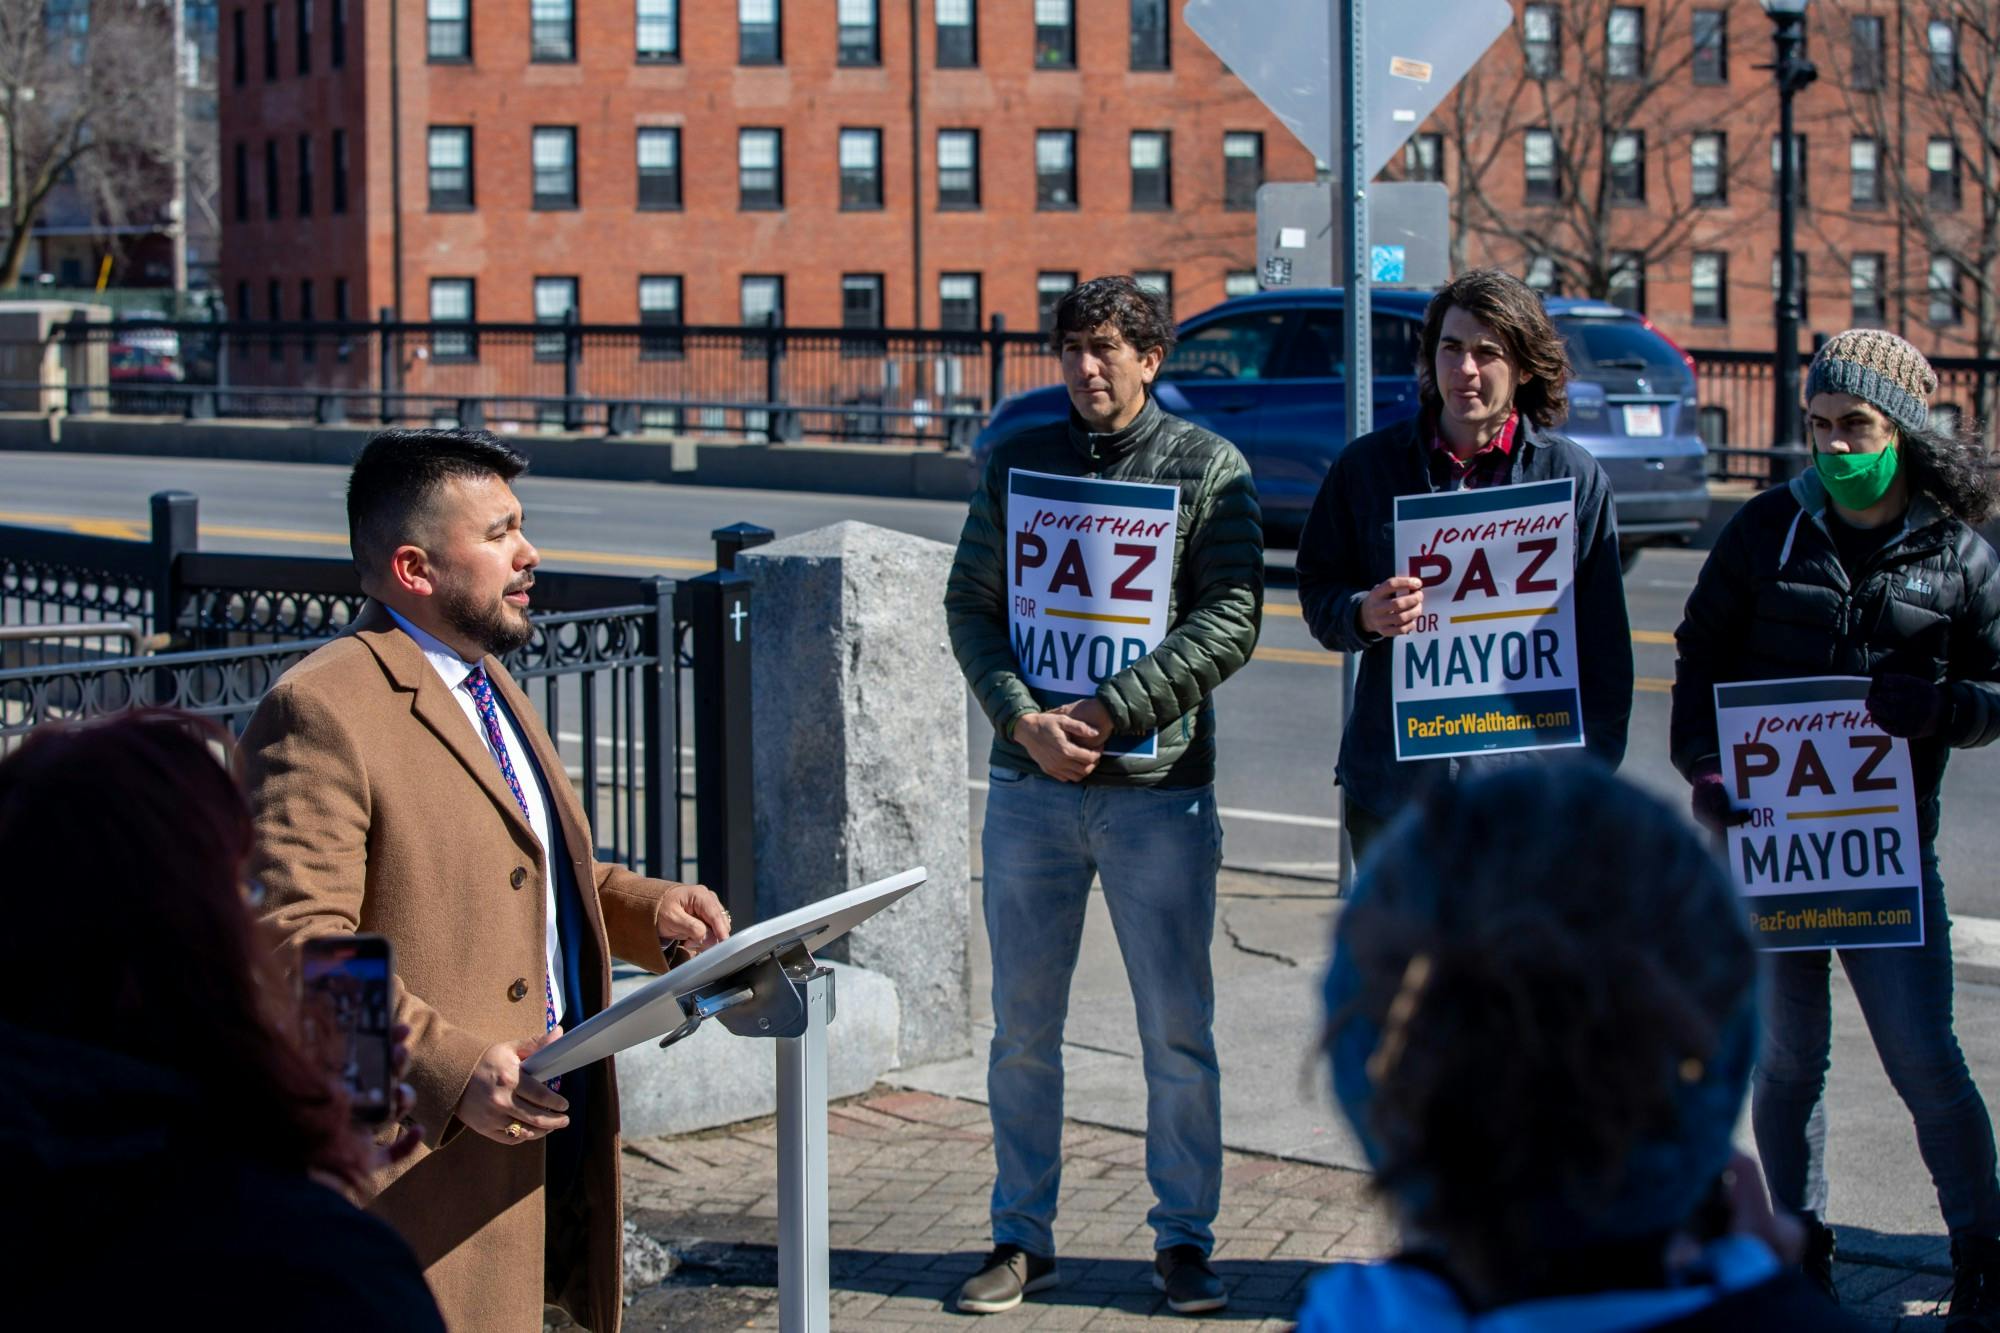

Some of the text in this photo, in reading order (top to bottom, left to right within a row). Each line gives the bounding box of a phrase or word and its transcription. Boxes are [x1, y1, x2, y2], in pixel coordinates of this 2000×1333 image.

[1024, 509, 1170, 538] JONATHAN
[1421, 512, 1569, 559] JONATHAN
[1015, 530, 1157, 602] PAZ
[1408, 537, 1558, 602] PAZ
[1014, 594, 1036, 619] FOR
[1415, 613, 1439, 633] OR
[1405, 628, 1562, 690] MAYOR
[1407, 710, 1570, 738] PazForWaltham.com
[1744, 709, 1875, 744] JONATHA
[1732, 735, 1897, 800] PAZ
[1742, 807, 1775, 829] OR
[1741, 826, 1905, 885] MAYOR
[1749, 907, 1912, 932] PazForWaltham.com
